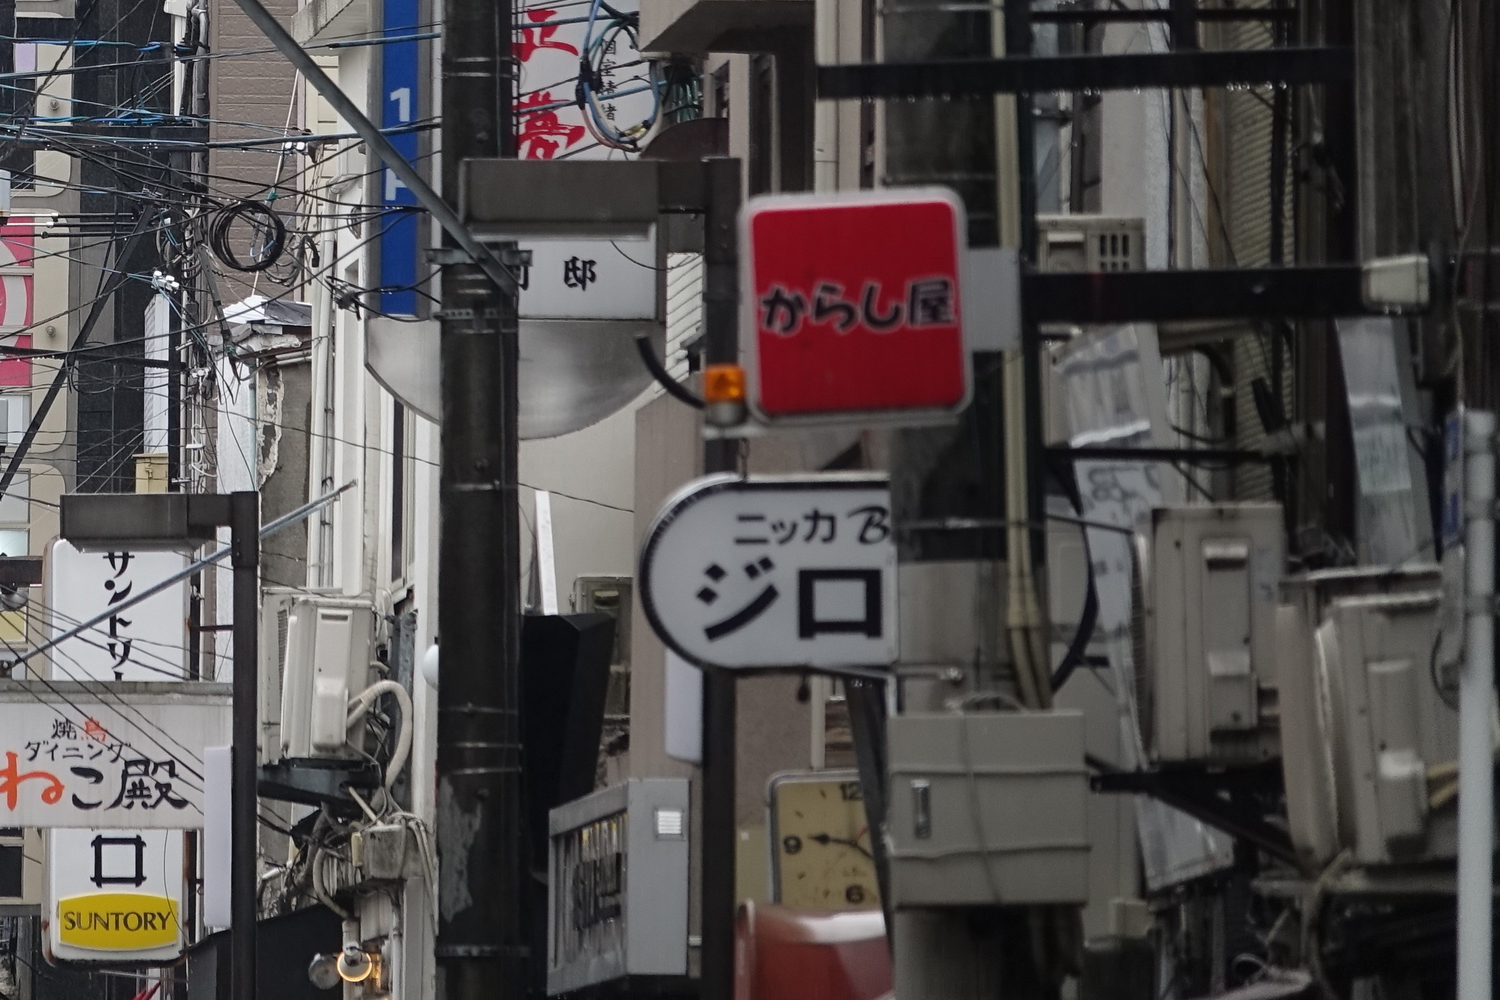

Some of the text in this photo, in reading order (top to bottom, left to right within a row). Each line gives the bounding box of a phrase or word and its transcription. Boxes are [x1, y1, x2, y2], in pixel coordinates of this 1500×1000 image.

[760, 280, 955, 335] からし屋
[734, 508, 836, 545] ニッカ
[697, 556, 882, 641] ジロ
[51, 717, 108, 743] 焼鳥
[25, 740, 132, 765] ダイニング
[63, 911, 172, 931] SUNTORY
